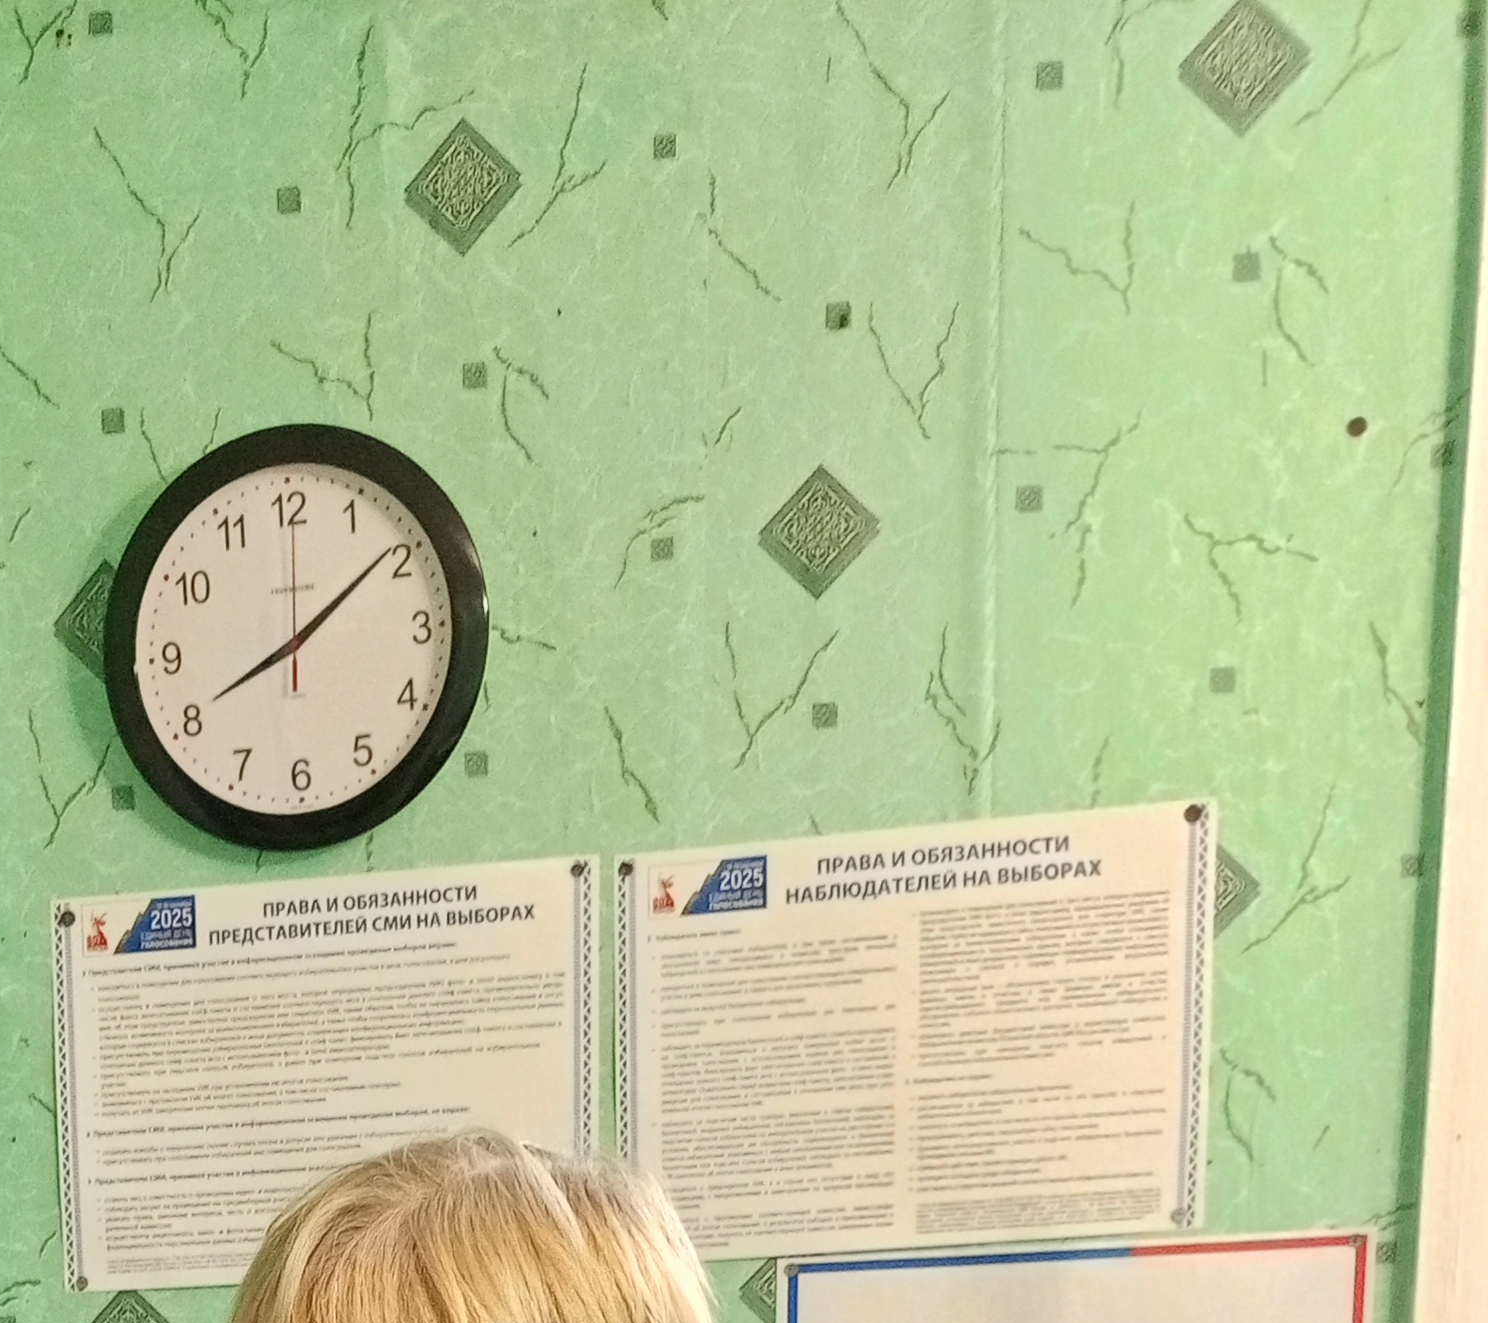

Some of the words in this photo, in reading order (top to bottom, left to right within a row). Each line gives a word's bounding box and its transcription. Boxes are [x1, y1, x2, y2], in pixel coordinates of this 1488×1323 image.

[271, 491, 307, 527] 12
[343, 501, 357, 534] 1
[217, 516, 246, 550] 11
[391, 543, 412, 578] 2
[175, 570, 211, 605] 10
[411, 611, 431, 644] 3
[161, 642, 181, 674] 9
[396, 678, 417, 712] 4
[183, 704, 202, 736] 8
[232, 748, 252, 781] 7
[352, 734, 373, 767] 5
[291, 759, 311, 790] 6
[817, 852, 885, 876] ПРАВА
[892, 852, 904, 867] И
[911, 836, 1070, 865] ОБЯЗАННОСТИ
[719, 867, 764, 892] 2025
[786, 870, 956, 904] НАБЛЮДАТЕЛЕЙ
[962, 869, 990, 888] НА
[998, 859, 1102, 885] ВЫБОРАХ
[150, 907, 193, 930] 2025
[263, 898, 321, 918] ПРАВА
[327, 896, 338, 912] И
[343, 886, 477, 914] ОБЯЗАННОСТИ
[209, 915, 368, 947] ПРЕДСТАВИТЕЛЕЙ
[373, 913, 411, 932] СМИ
[417, 911, 442, 929] НА
[447, 904, 535, 925] ВЫБОРАХ
